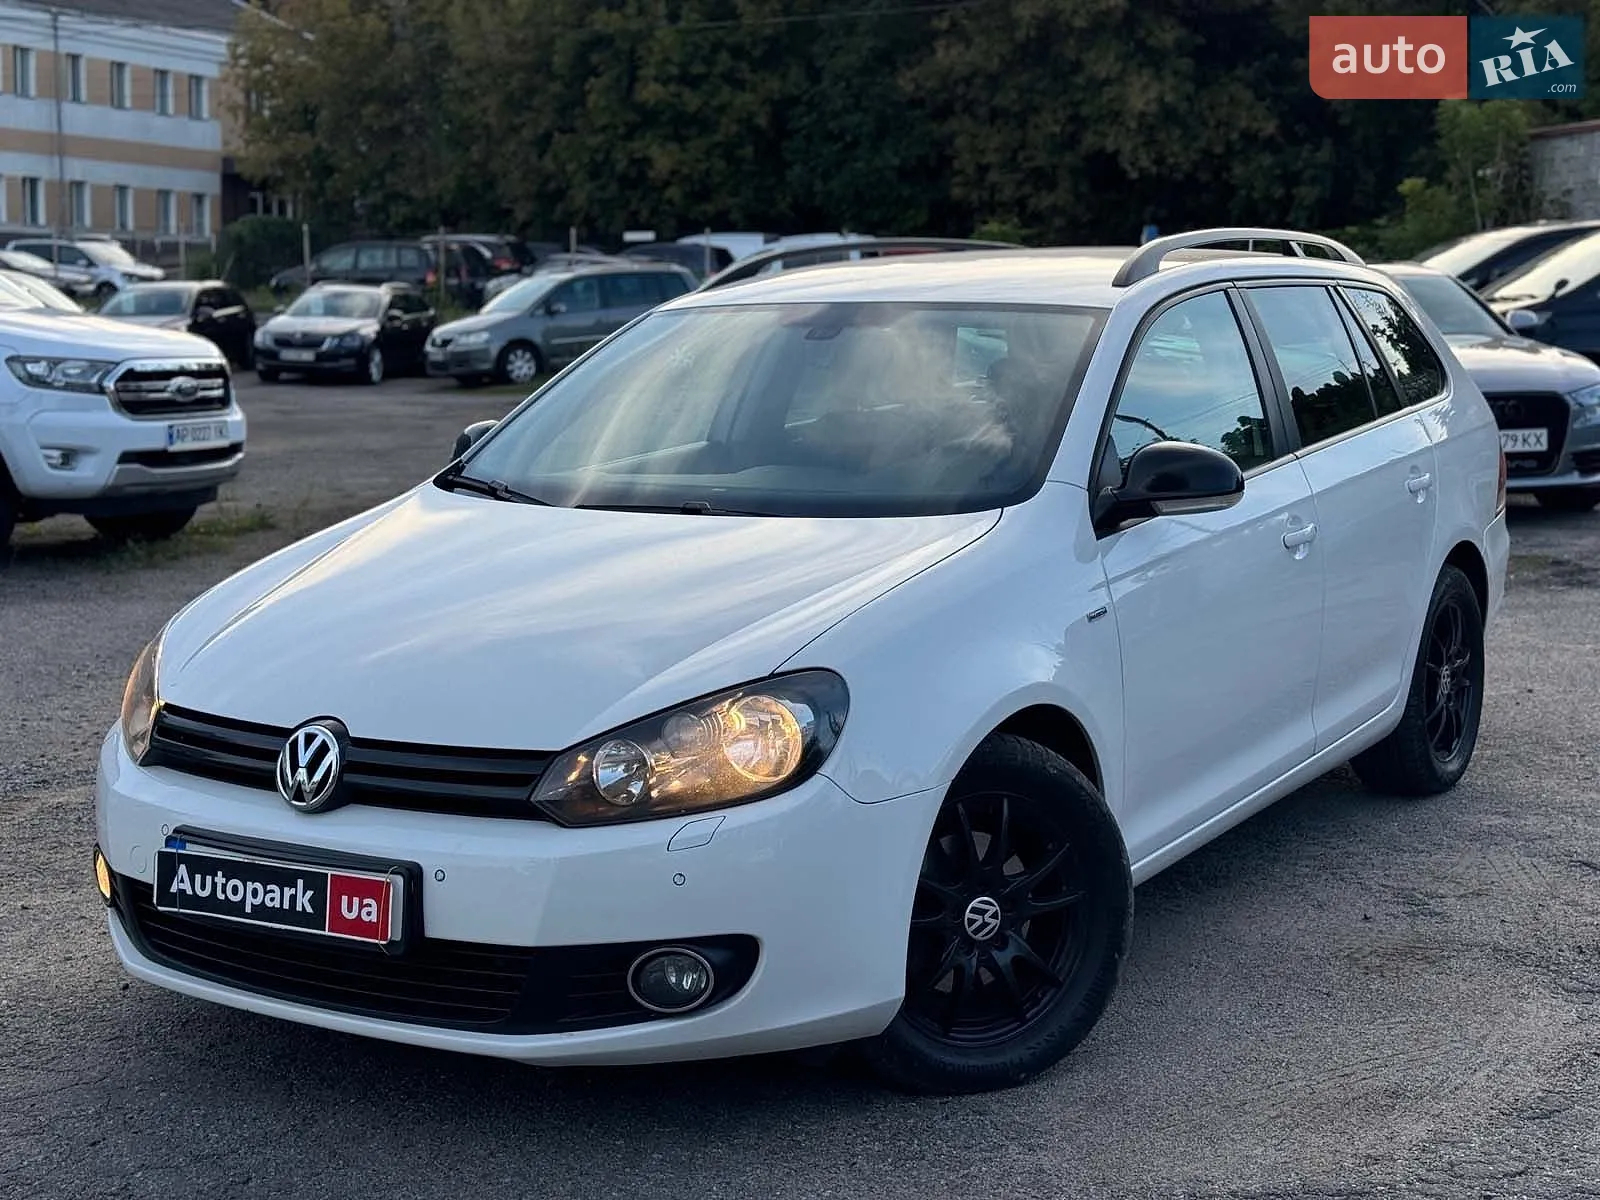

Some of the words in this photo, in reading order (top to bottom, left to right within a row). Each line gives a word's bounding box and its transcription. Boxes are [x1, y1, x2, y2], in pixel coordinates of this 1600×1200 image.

[1522, 431, 1544, 448] KX
[170, 864, 314, 913] Autopark
[341, 895, 378, 923] ua
